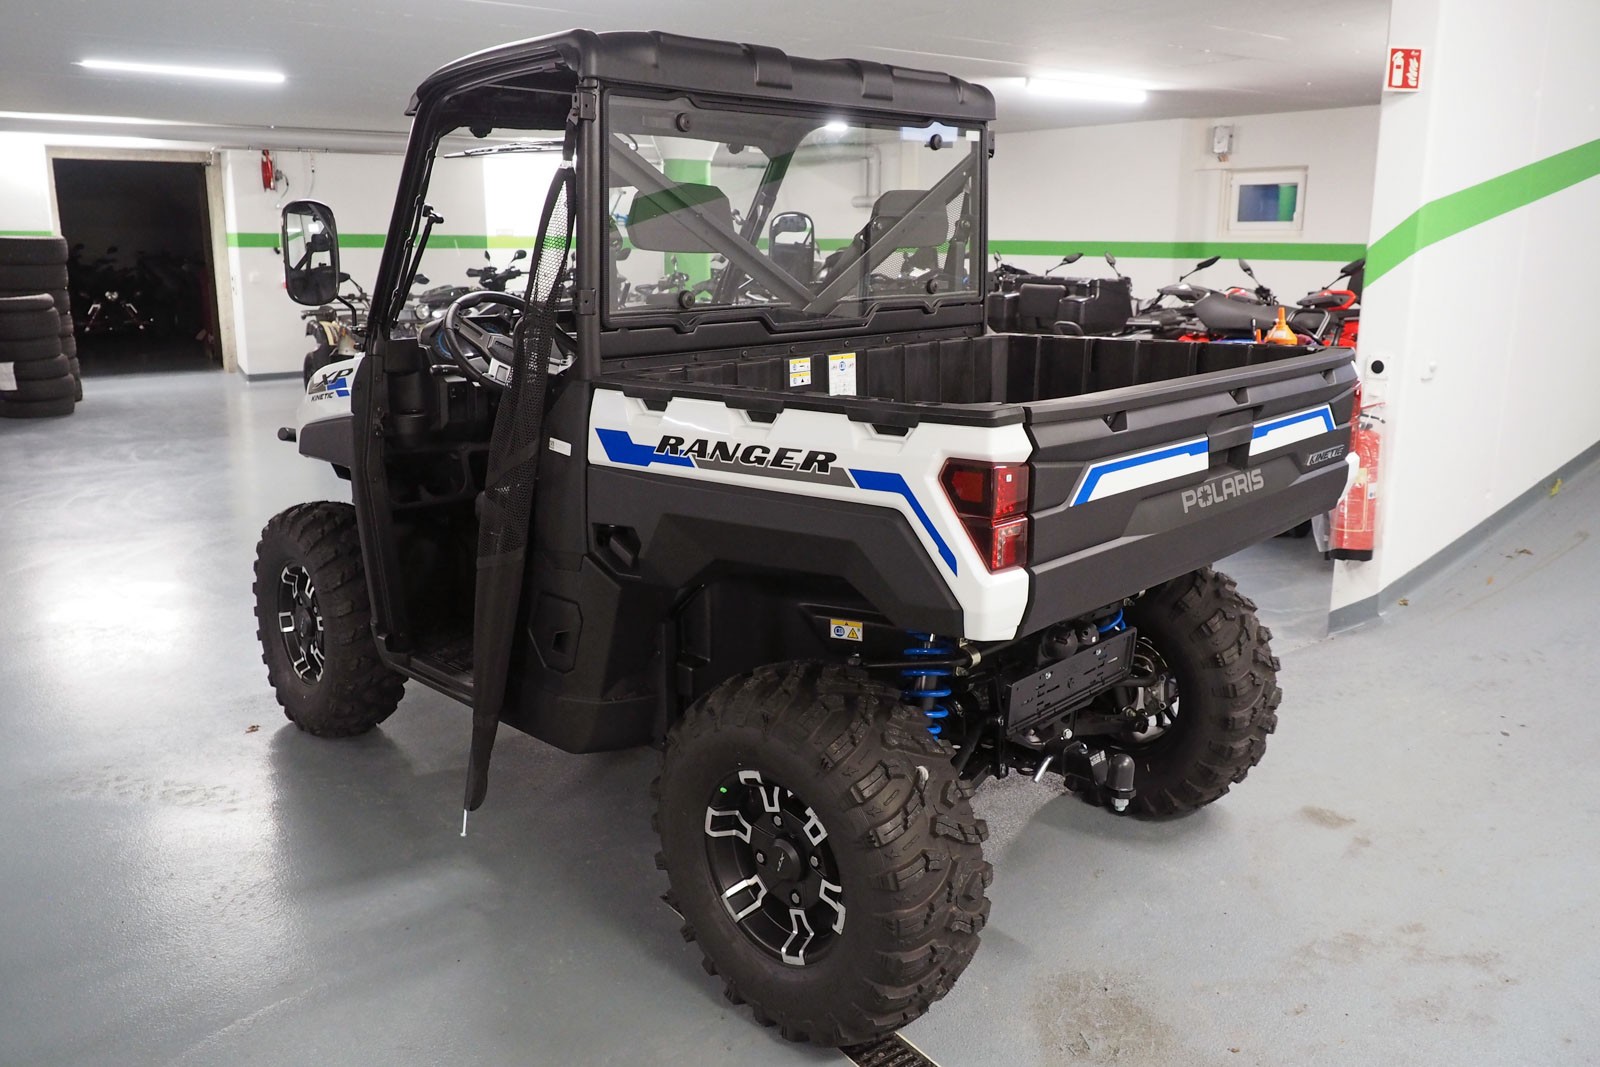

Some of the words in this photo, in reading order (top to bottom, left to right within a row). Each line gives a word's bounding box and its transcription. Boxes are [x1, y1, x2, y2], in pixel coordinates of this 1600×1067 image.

[315, 367, 353, 388] XP
[311, 392, 334, 401] KINETIC
[655, 435, 837, 473] RANGER
[1181, 468, 1264, 513] POLARIS
